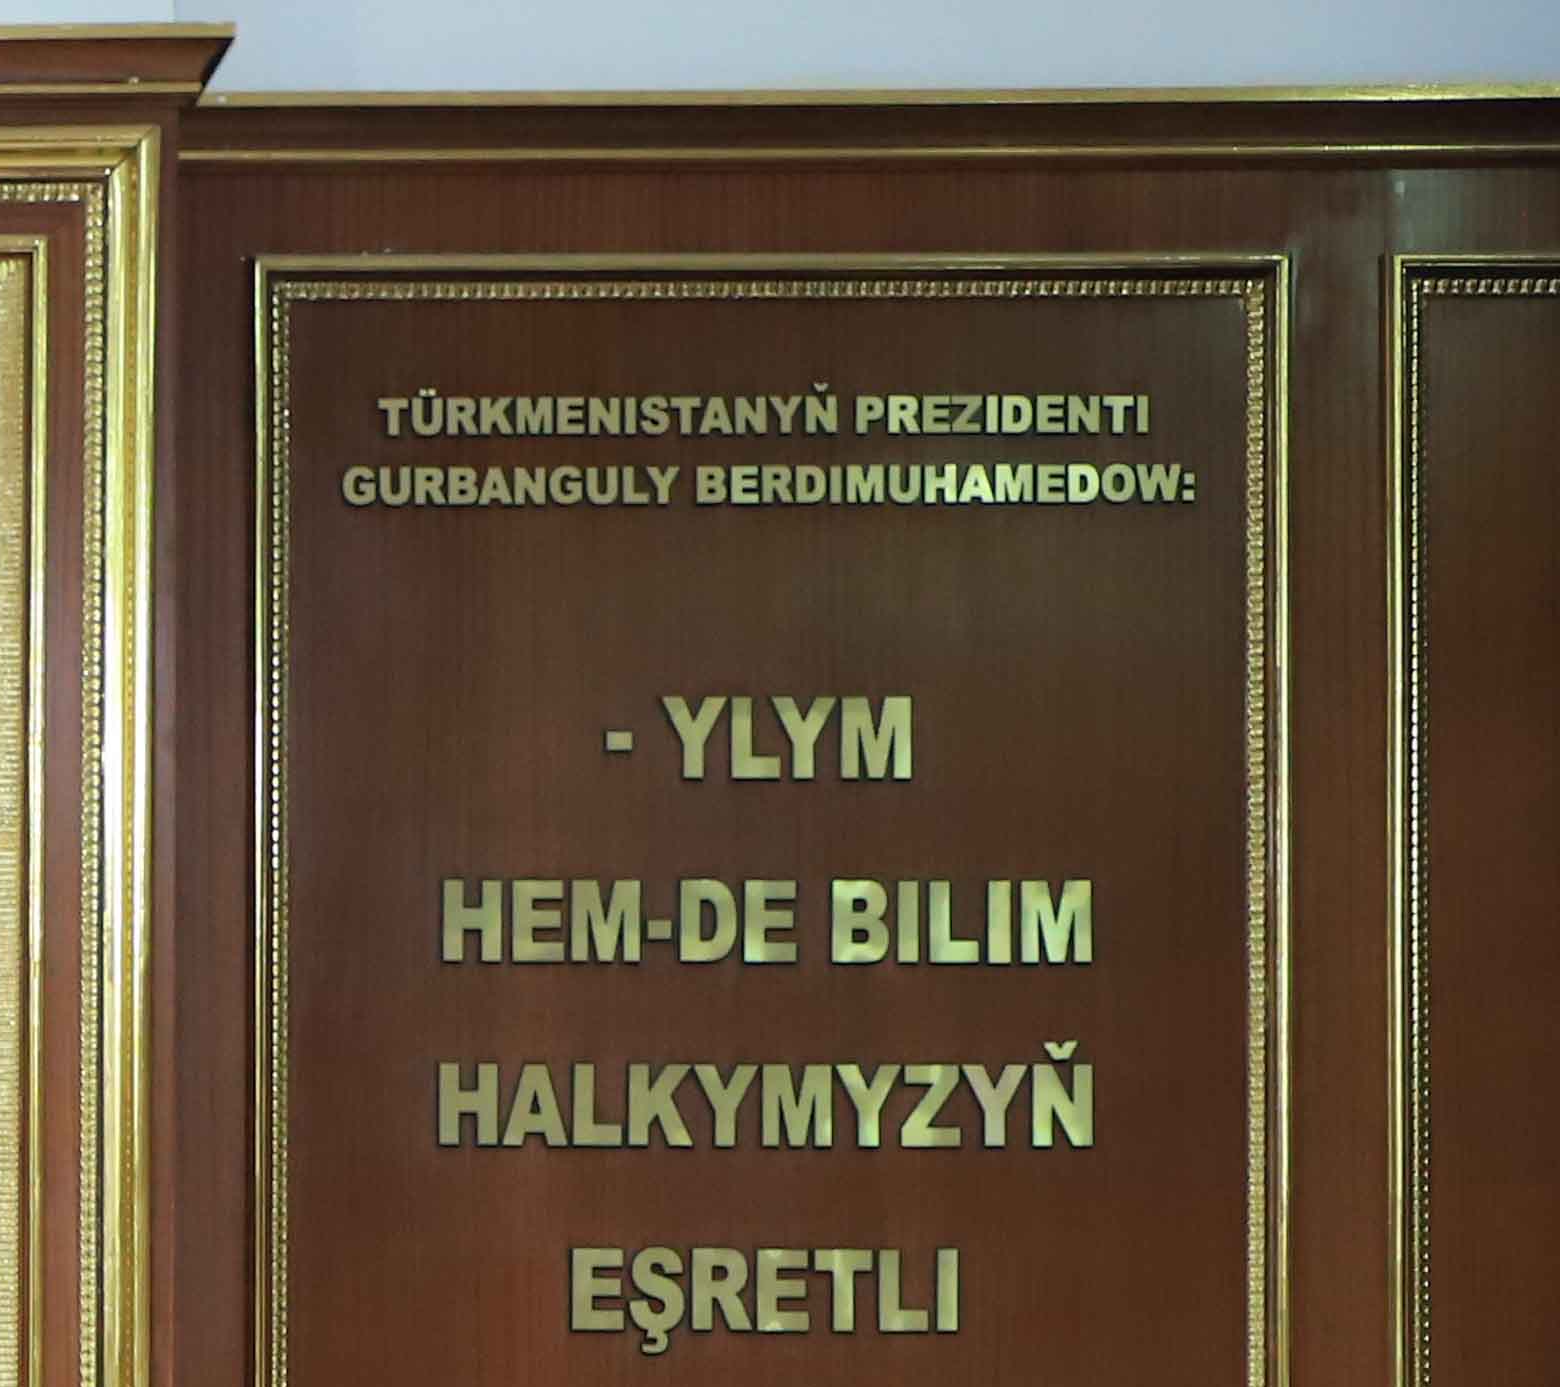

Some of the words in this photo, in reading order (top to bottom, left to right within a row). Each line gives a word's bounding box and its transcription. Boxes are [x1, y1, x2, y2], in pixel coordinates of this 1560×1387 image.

[377, 381, 839, 437] TÜRKMENISTANYŇ
[855, 393, 1150, 435] PREZIDENTI
[341, 464, 681, 506] GURBANGULY
[696, 462, 1196, 505] BERDIMUHAMEDOW:
[605, 730, 634, 752] -
[662, 695, 913, 780] YLYM
[442, 877, 798, 964] HEM-DE
[830, 878, 1094, 965] BILIM
[438, 1039, 1094, 1148] HALKYMYZYŇ
[571, 1246, 959, 1354] EŞRETLI
